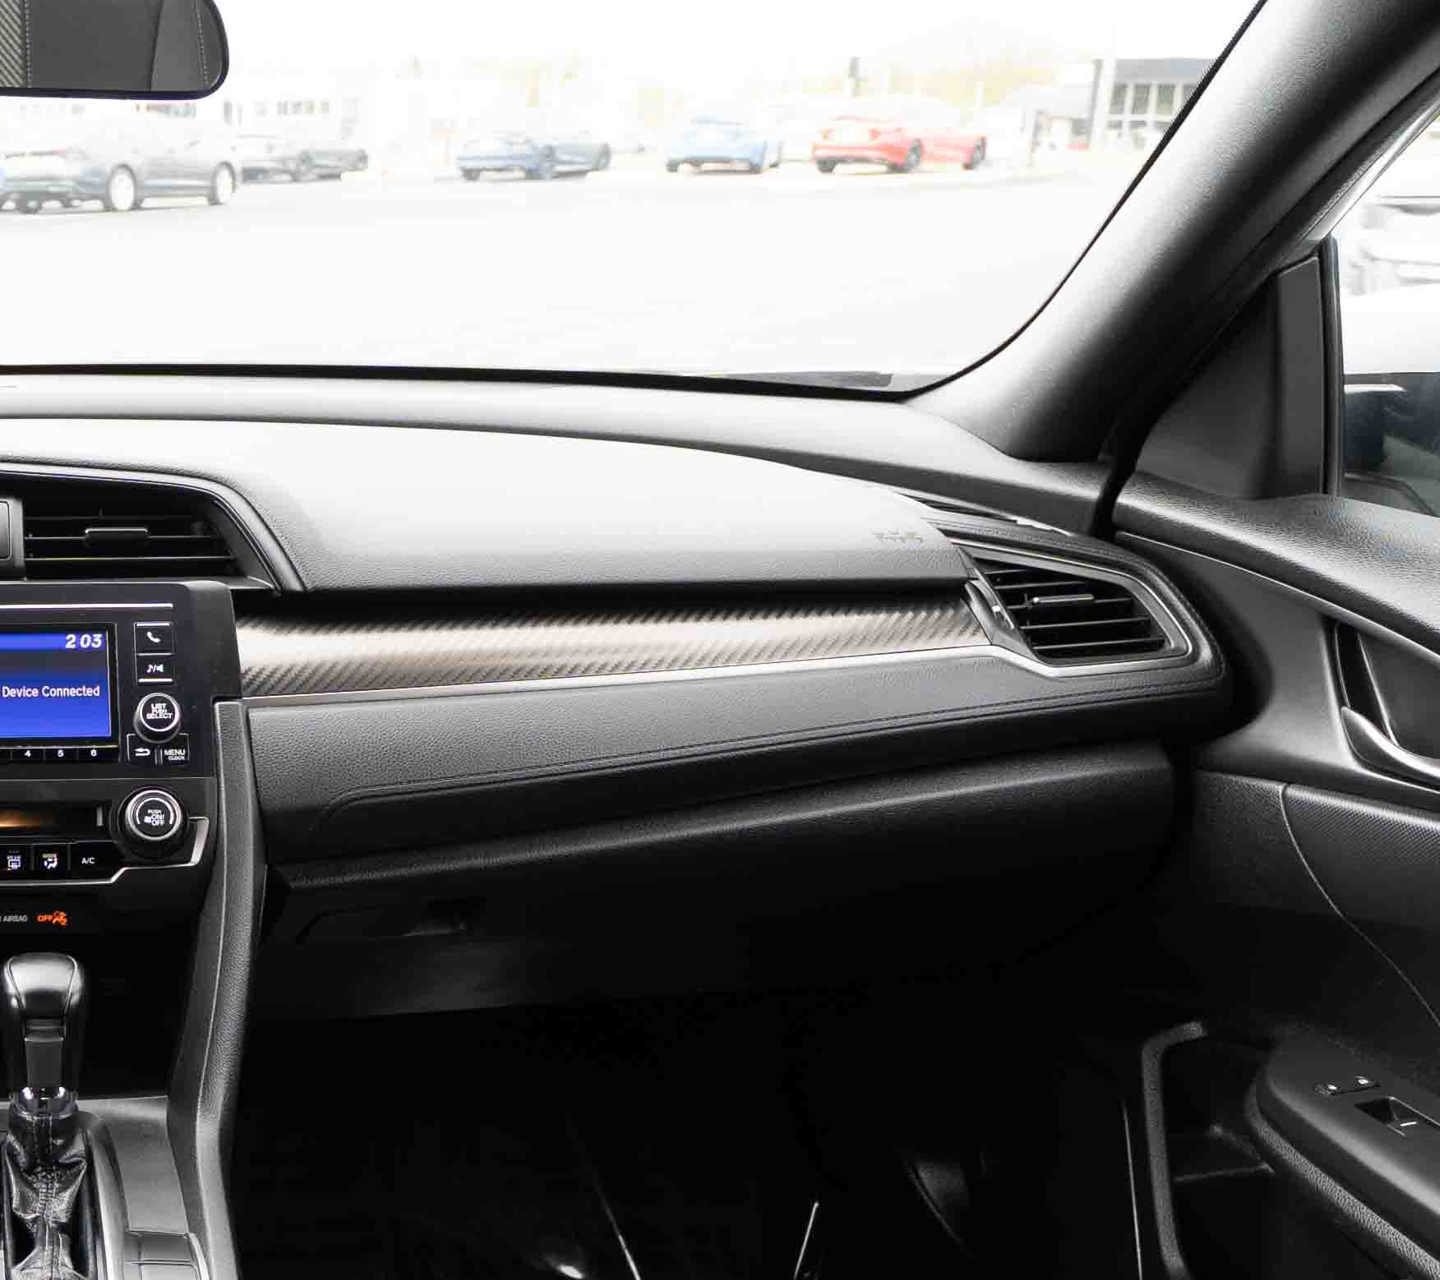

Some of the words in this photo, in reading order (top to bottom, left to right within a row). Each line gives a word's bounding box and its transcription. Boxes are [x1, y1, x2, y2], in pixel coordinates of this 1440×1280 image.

[2, 685, 39, 698] Device
[42, 685, 101, 698] Connected
[164, 748, 186, 756] MENU
